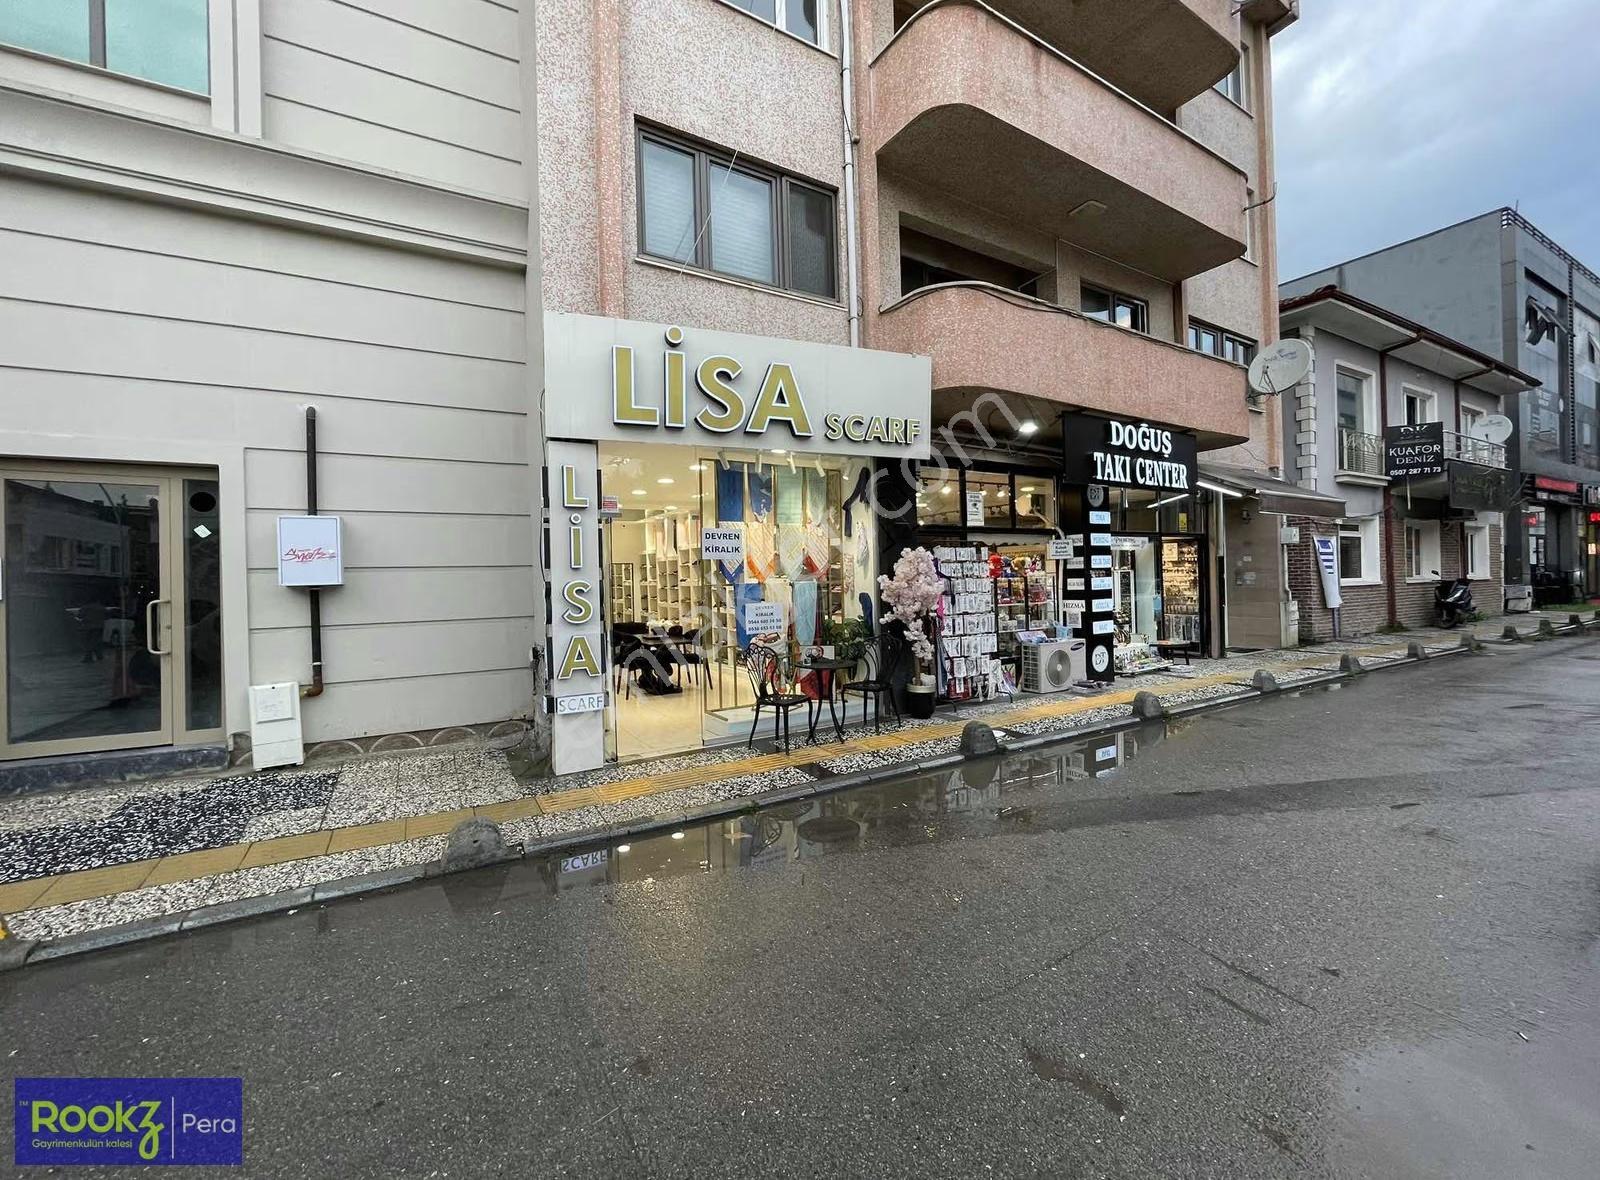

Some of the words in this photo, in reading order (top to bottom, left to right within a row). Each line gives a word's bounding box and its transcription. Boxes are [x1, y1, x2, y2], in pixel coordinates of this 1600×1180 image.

[612, 326, 814, 438] LİSA
[825, 411, 921, 444] SCARF
[1110, 420, 1172, 458] DOĞUŞ
[1093, 451, 1132, 483] TAKI
[1136, 457, 1189, 489] CENTER
[1396, 454, 1435, 465] DENİZ
[705, 532, 740, 540] DEVREN
[705, 545, 741, 553] KİRALIK
[557, 465, 601, 680] LİSA
[559, 696, 604, 713] SCARF
